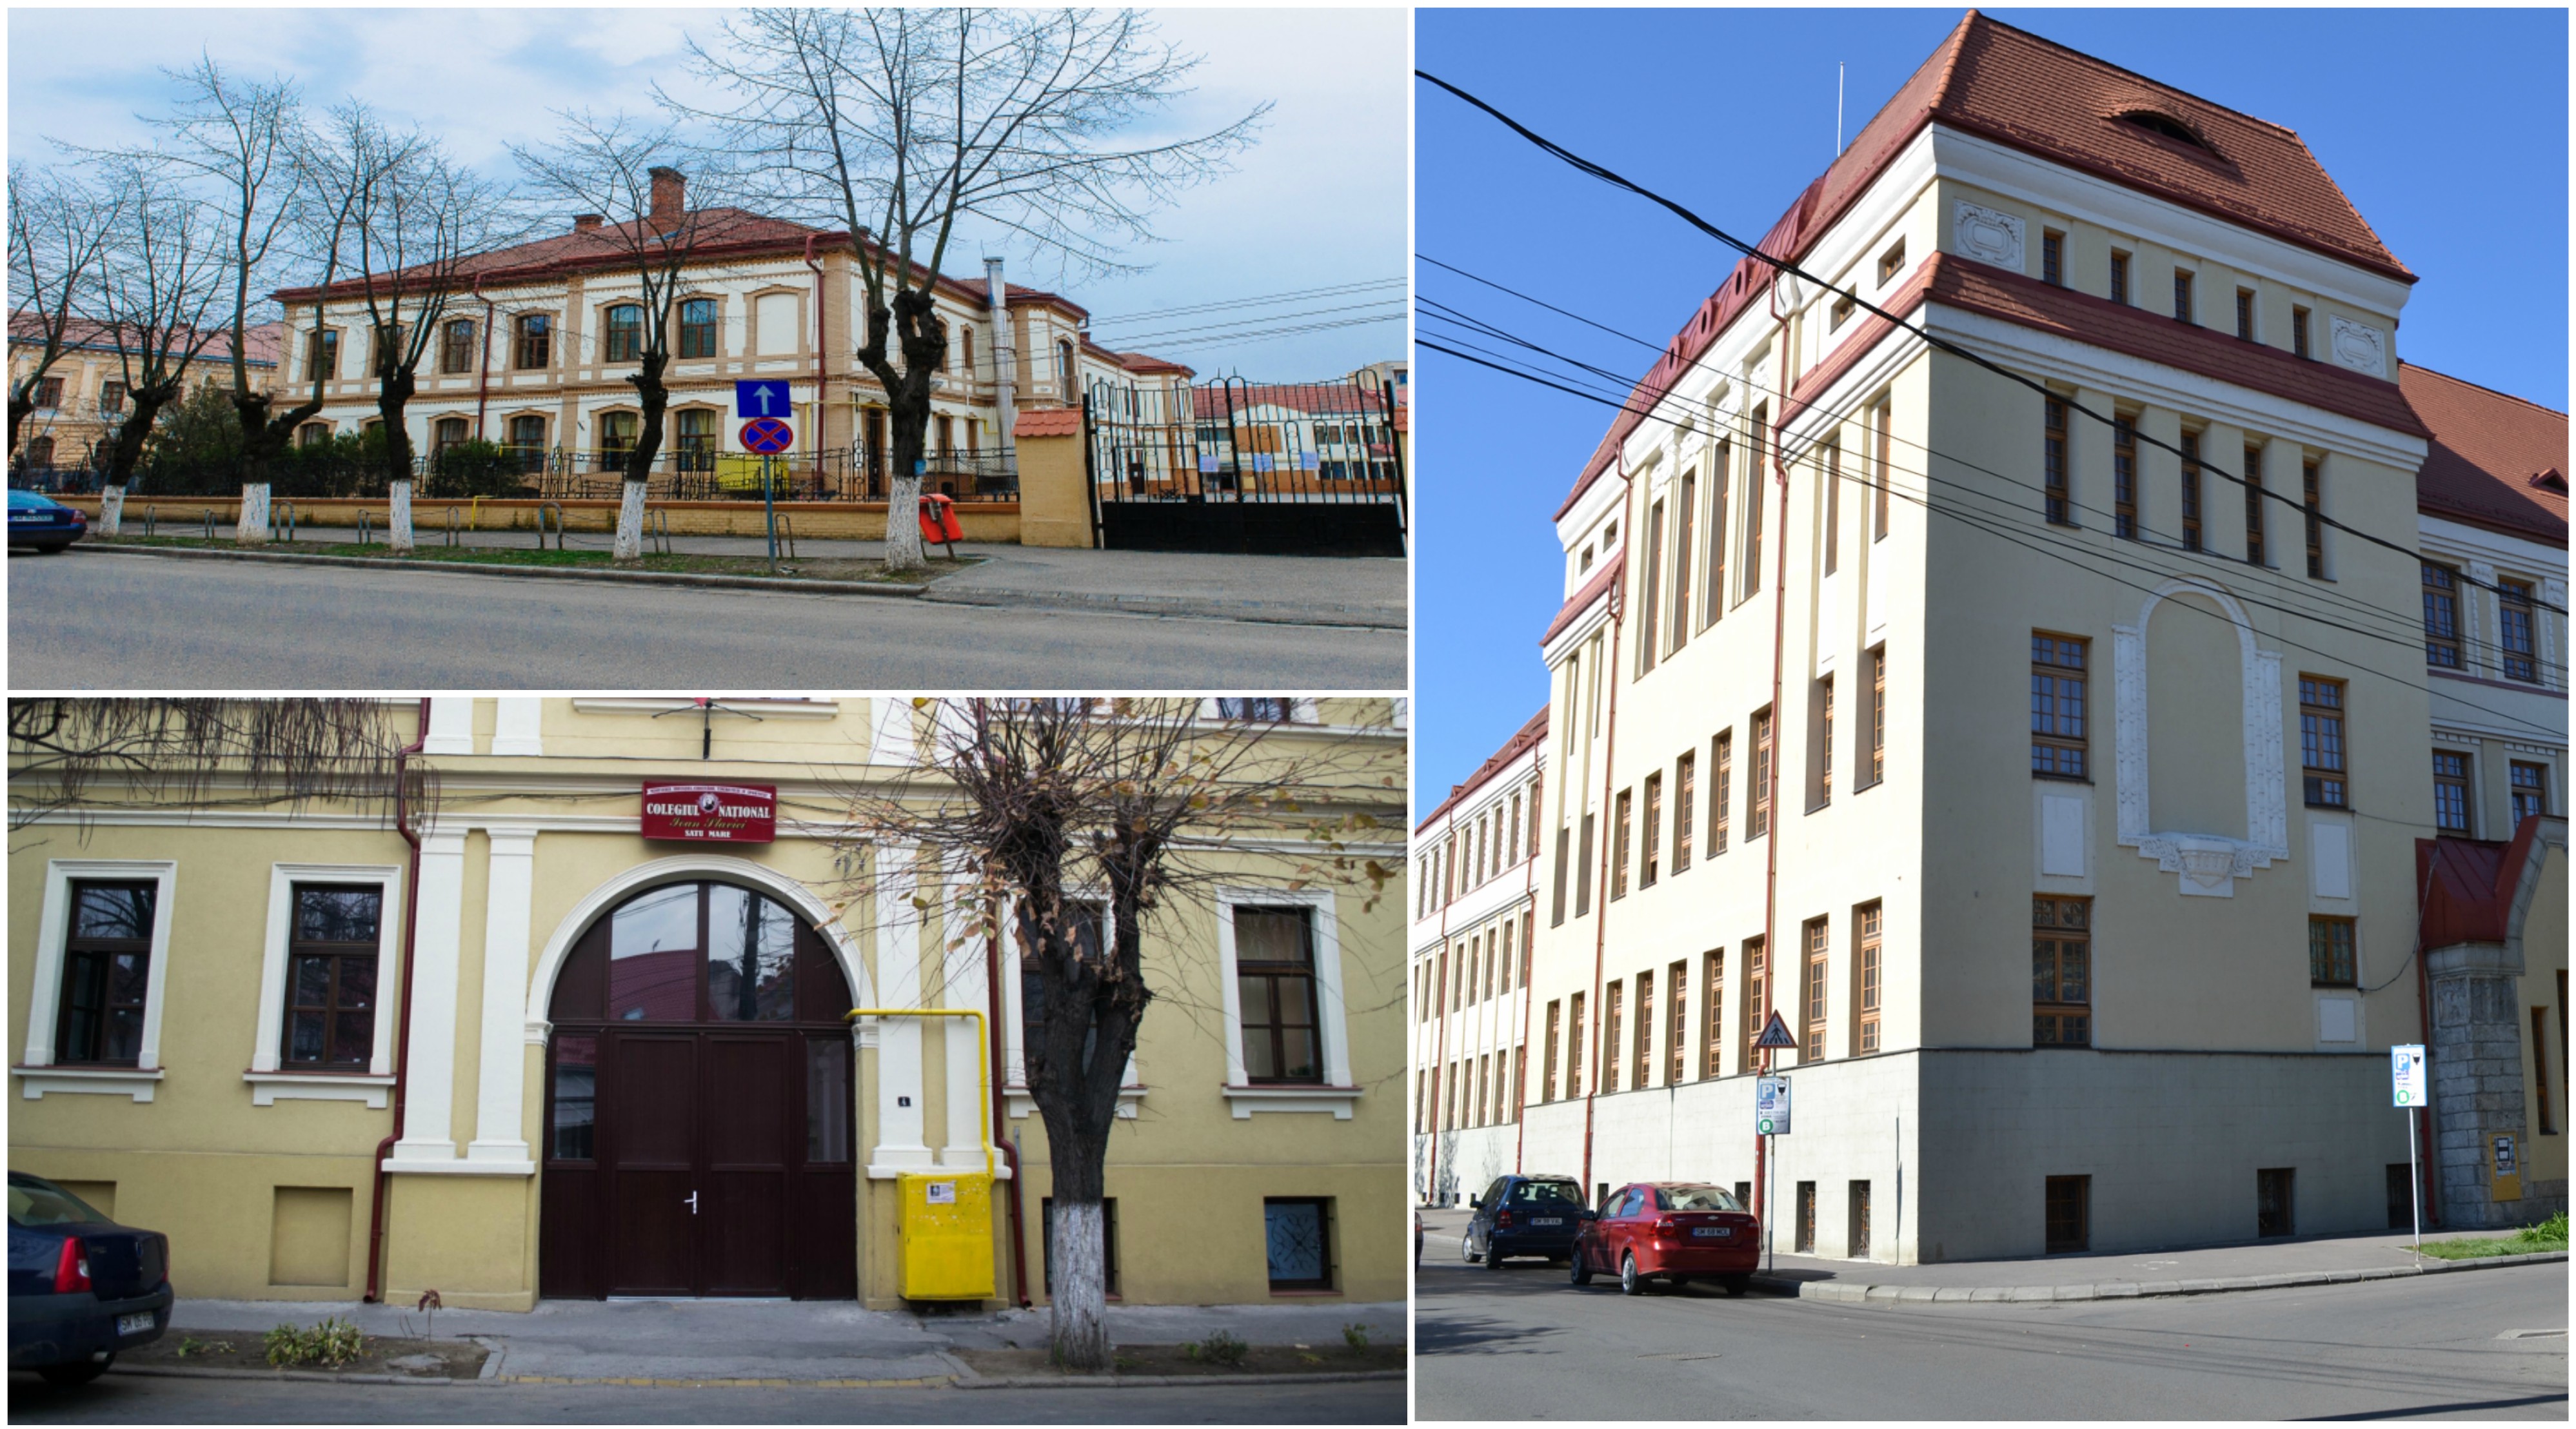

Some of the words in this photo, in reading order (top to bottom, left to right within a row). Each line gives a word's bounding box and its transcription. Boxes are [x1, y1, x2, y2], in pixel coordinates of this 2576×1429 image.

[647, 803, 700, 816] COLEGIUL
[669, 817, 699, 828] Ioan
[704, 818, 747, 829] Slavici
[2397, 1055, 2409, 1068] P
[1762, 1085, 1773, 1098] P
[1762, 1121, 1770, 1131] B
[121, 1316, 132, 1331] SM
